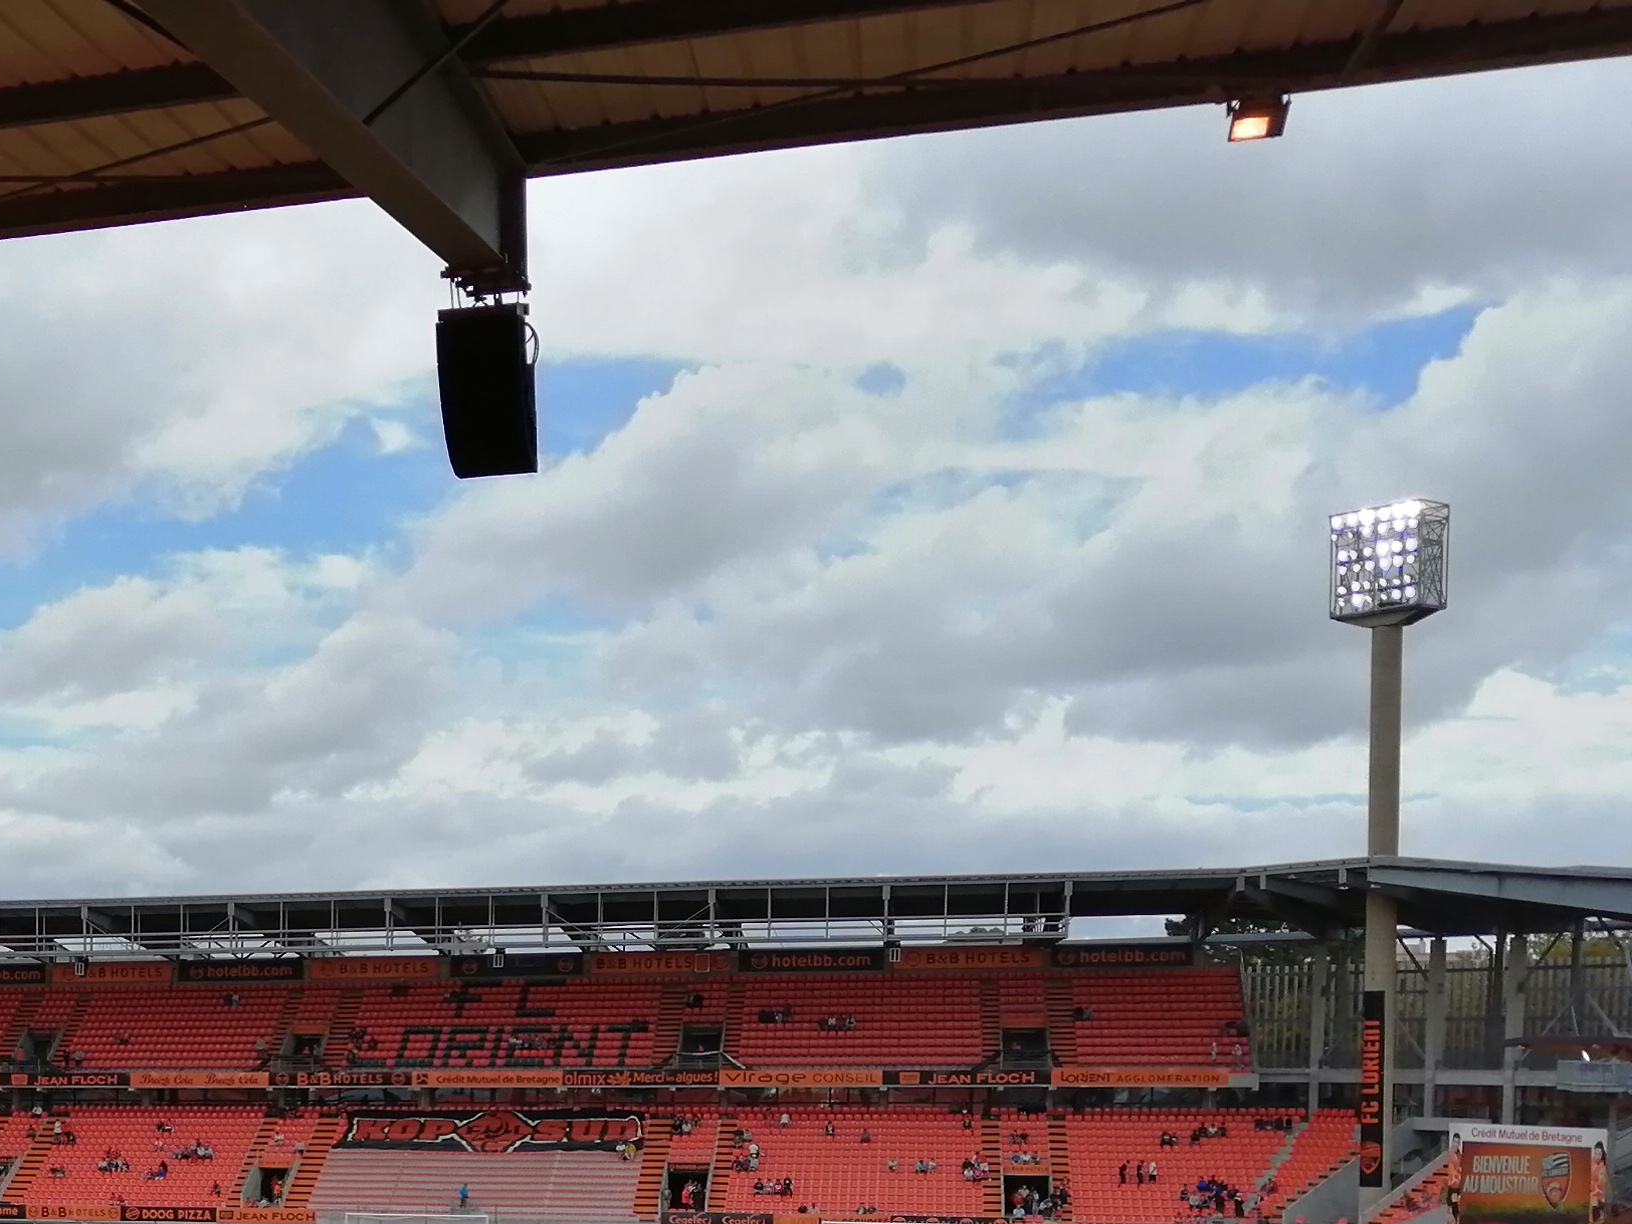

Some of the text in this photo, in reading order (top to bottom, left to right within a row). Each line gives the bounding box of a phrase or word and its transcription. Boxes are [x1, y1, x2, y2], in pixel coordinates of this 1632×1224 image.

[772, 954, 871, 967] hotelbb.com
[965, 953, 1030, 963] HOTELS
[1080, 951, 1186, 962] hotelbb.com
[373, 963, 429, 974] HOTELS
[633, 957, 692, 969] HOTELS
[111, 967, 163, 978] HOTELS
[208, 965, 293, 977] hotelbb.com
[633, 1072, 665, 1083] Merci
[1361, 1020, 1381, 1124] FC LORIENT
[33, 1075, 67, 1086] JEAN
[297, 1072, 384, 1086] B&B HOTELS
[436, 1074, 560, 1085] Crédit Mutuel de Bretagne
[725, 1072, 877, 1085] virage CONSEIL
[928, 1073, 971, 1085] JEAN
[532, 1118, 640, 1143] SUD
[1471, 1127, 1583, 1144] Crédit Mutuel de Bretagne
[1472, 1155, 1531, 1174] BIENVENUE
[1463, 1176, 1539, 1194] AU MOUSTOIR
[41, 1206, 106, 1218] B&B HOTELS
[141, 1210, 212, 1220] DOOG PIZZA
[236, 1211, 268, 1221] JEAN
